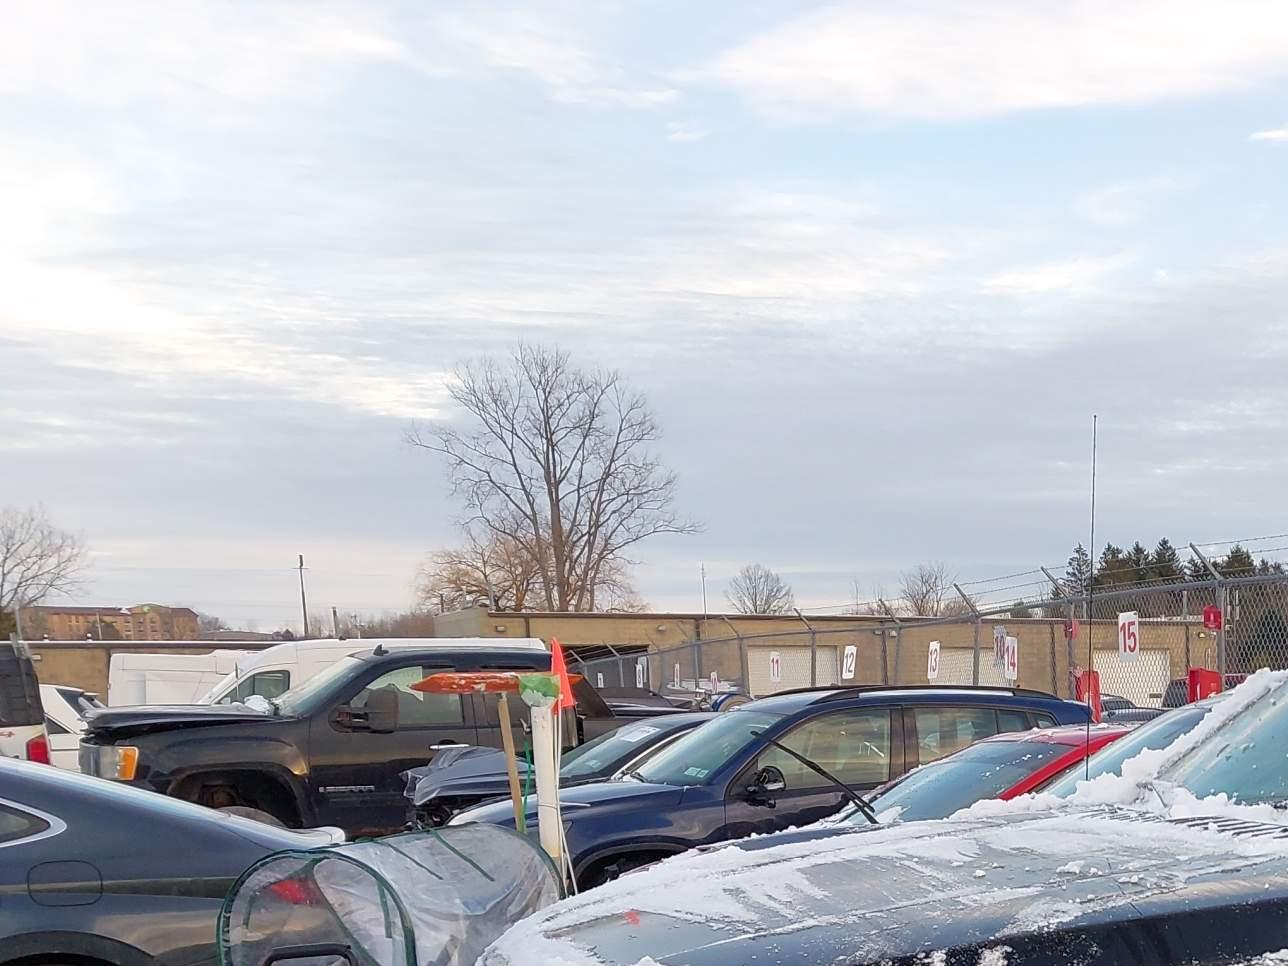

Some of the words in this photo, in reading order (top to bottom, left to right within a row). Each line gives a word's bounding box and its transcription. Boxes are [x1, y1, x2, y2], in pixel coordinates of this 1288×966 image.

[1119, 621, 1138, 654] 15
[771, 656, 780, 679] 11
[844, 651, 855, 674] 12
[929, 647, 938, 674] 13
[1005, 645, 1017, 673] 14
